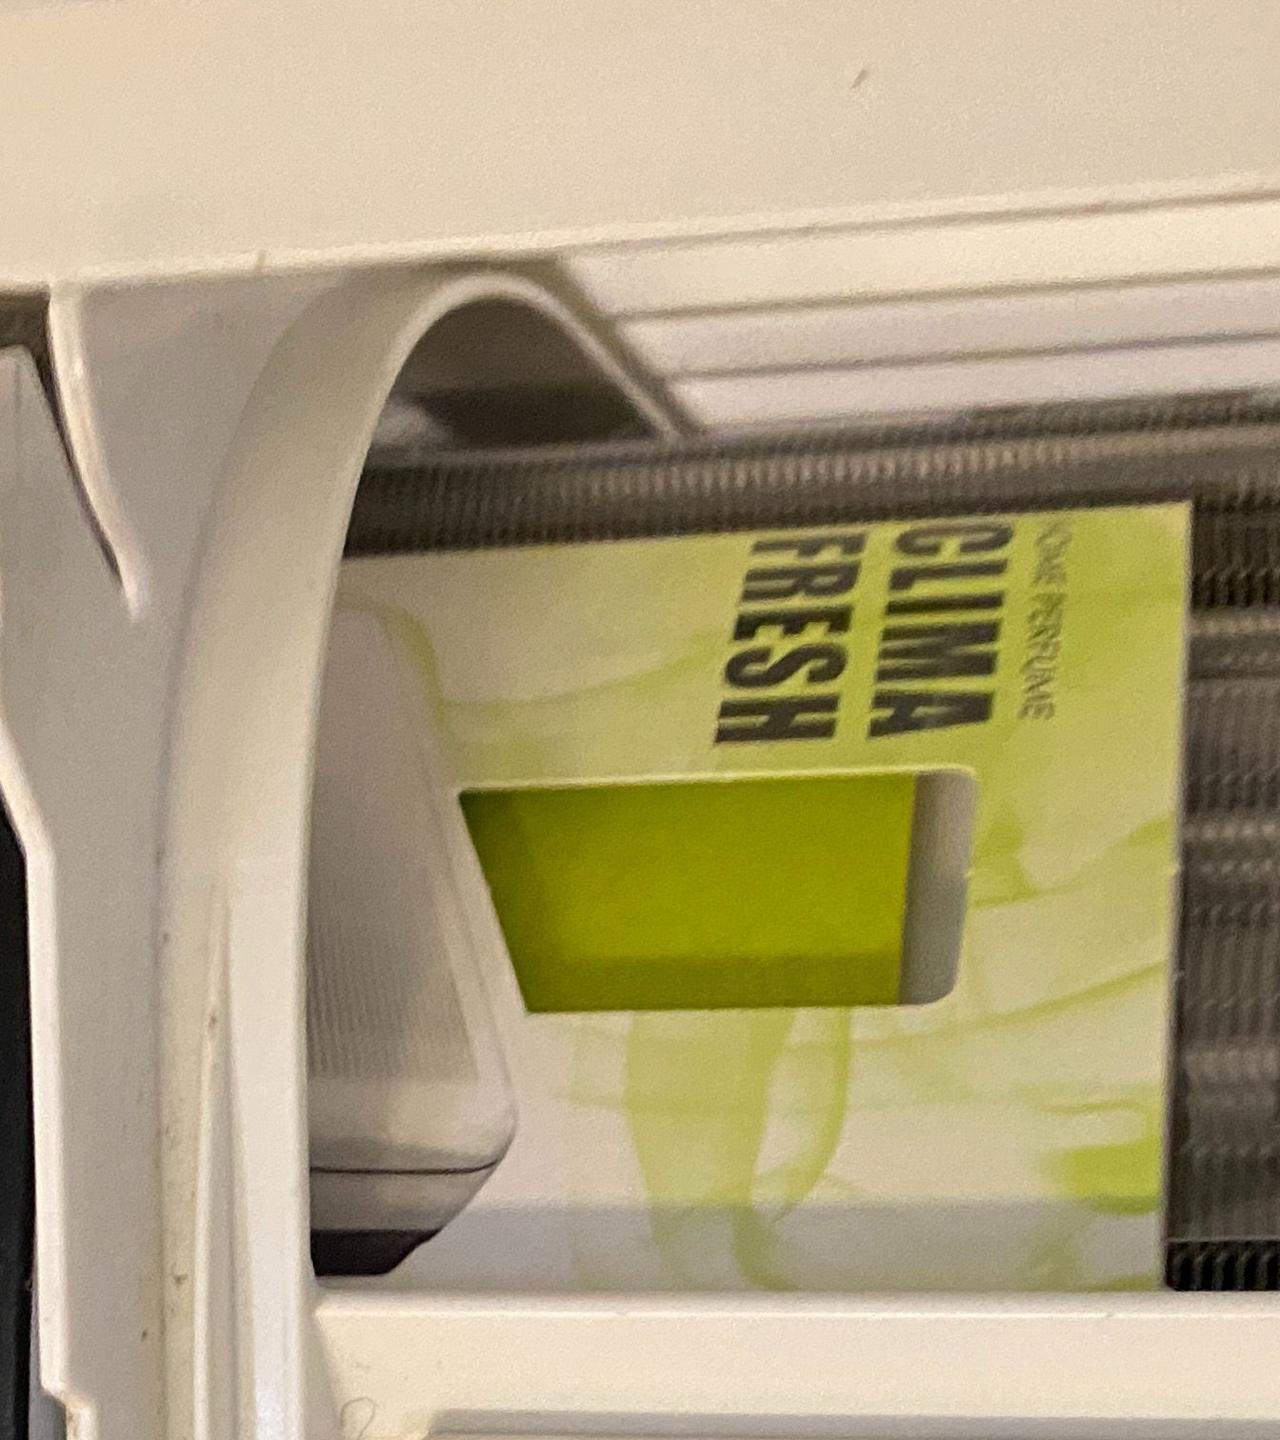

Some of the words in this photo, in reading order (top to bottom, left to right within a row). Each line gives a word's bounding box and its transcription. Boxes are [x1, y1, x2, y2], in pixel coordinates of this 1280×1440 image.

[715, 532, 868, 742] FRESH
[867, 522, 1014, 739] CLIMA
[1023, 592, 1067, 721] PERFUME
